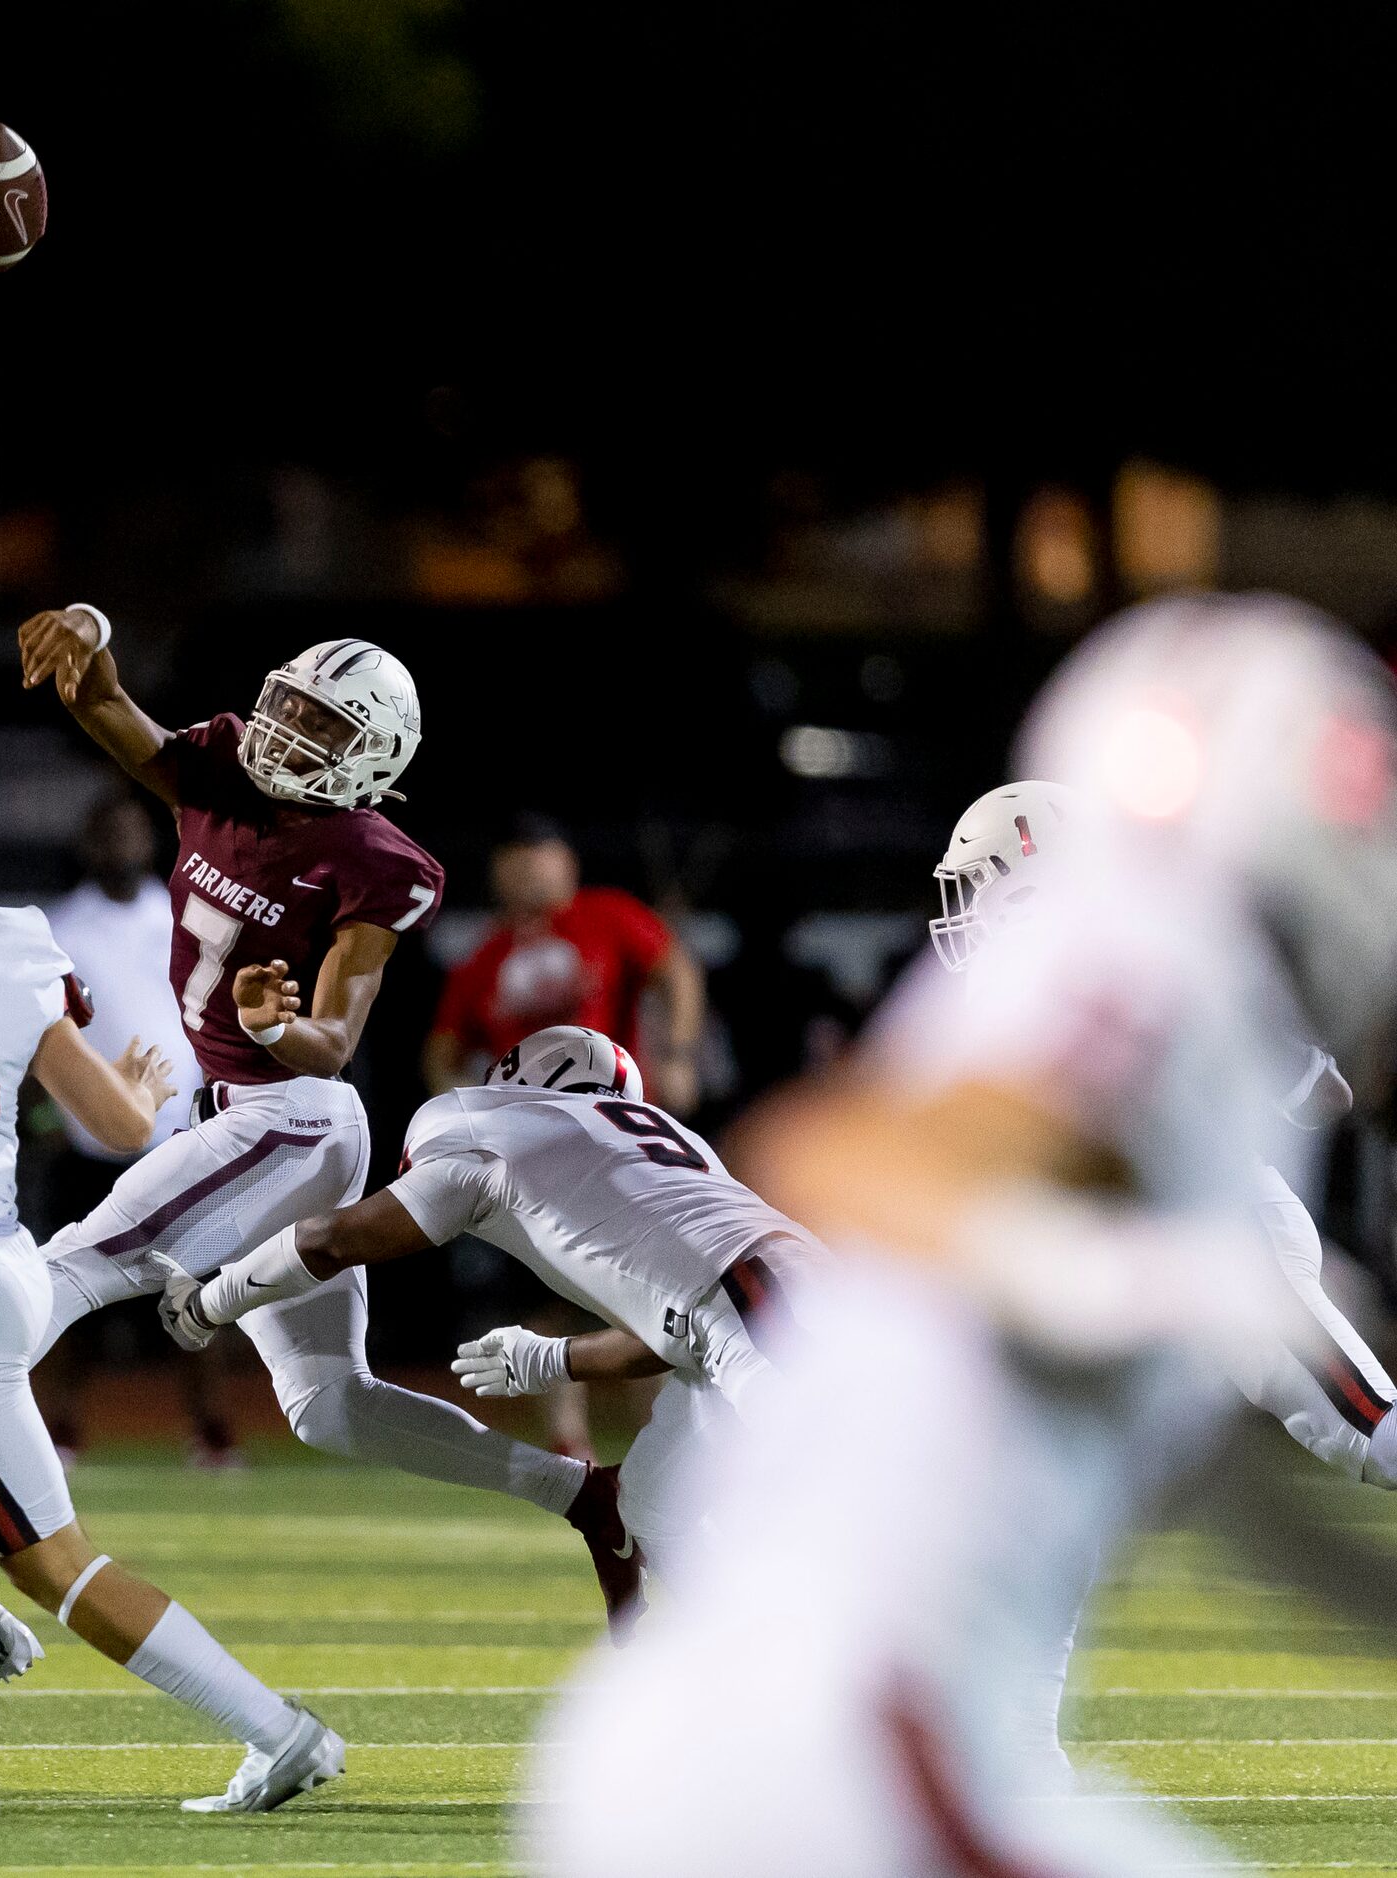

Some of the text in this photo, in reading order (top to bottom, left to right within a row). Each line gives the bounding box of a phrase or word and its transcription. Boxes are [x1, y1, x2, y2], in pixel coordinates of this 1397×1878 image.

[1013, 815, 1039, 858] 1
[181, 851, 286, 928] FARMERS
[390, 883, 437, 932] 7
[180, 891, 245, 1032] 7
[288, 1118, 333, 1129] FARMERS
[593, 1100, 710, 1174] 9
